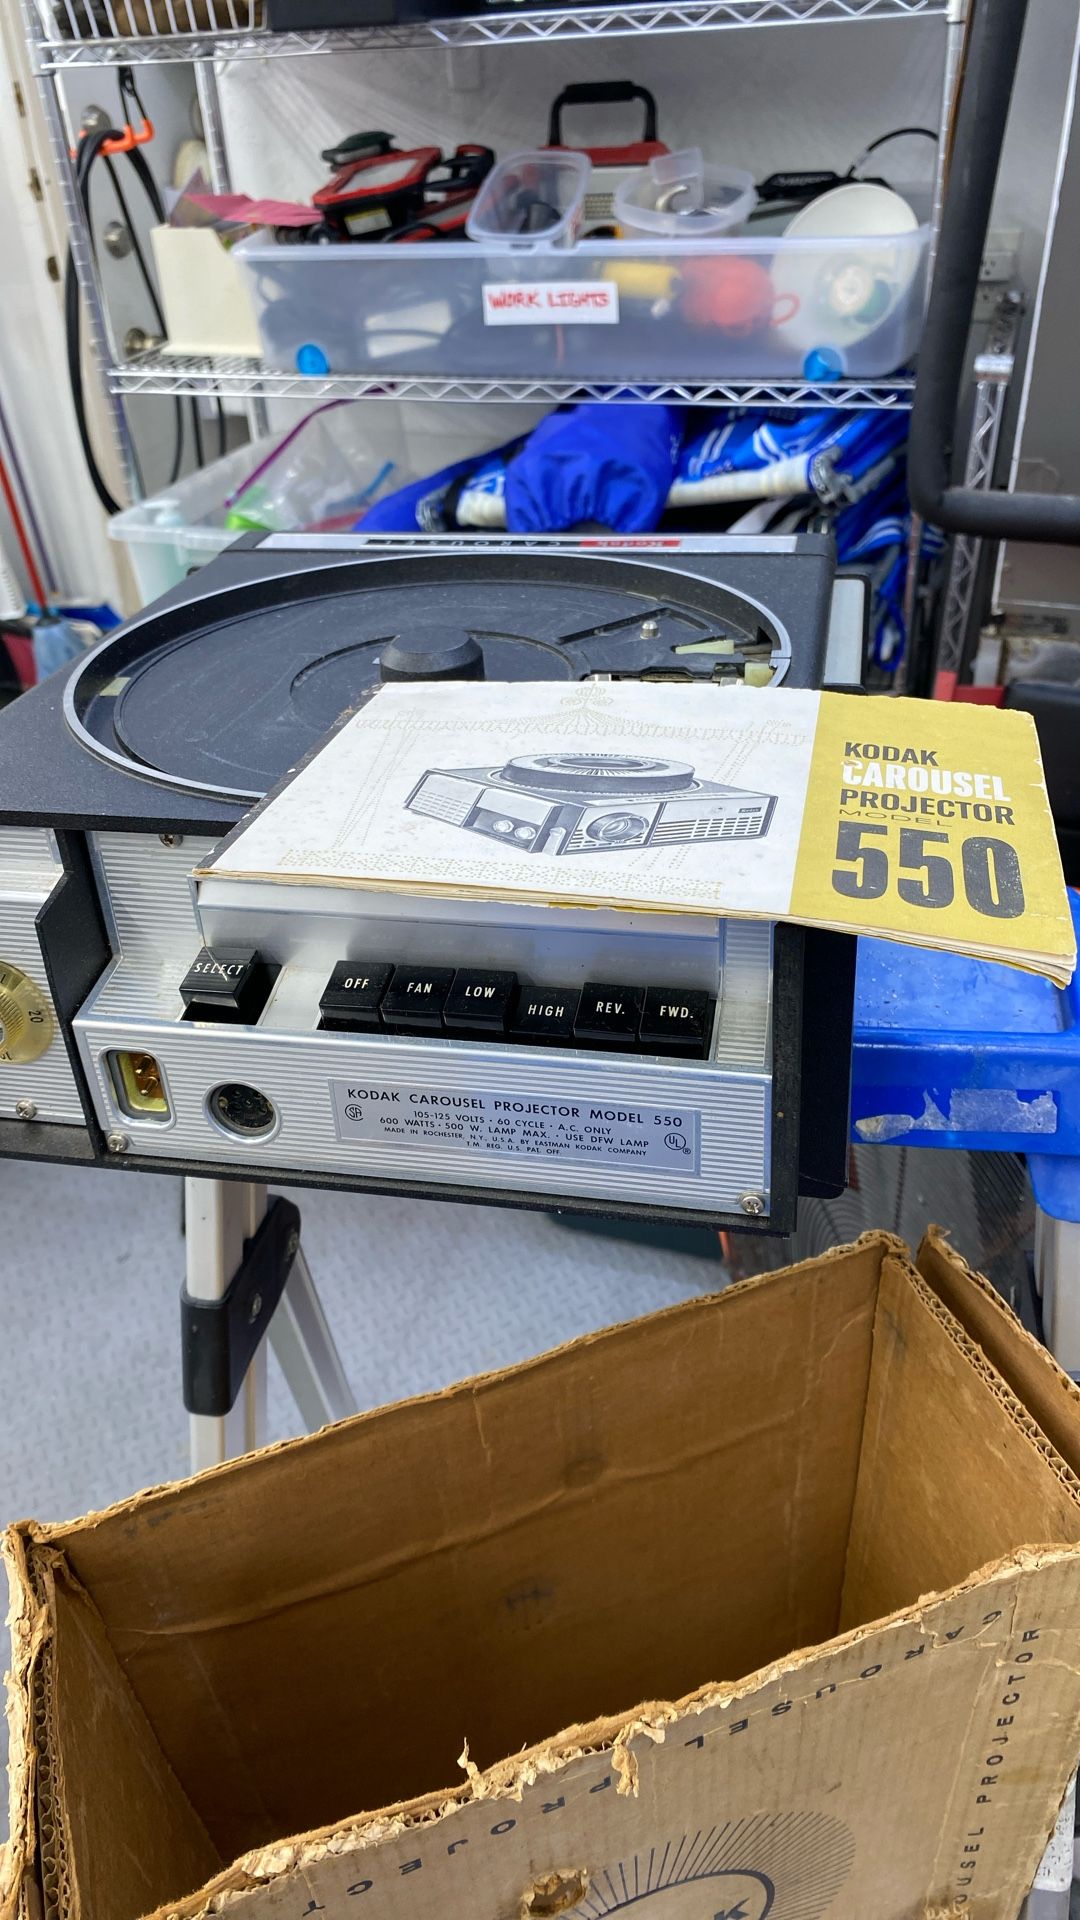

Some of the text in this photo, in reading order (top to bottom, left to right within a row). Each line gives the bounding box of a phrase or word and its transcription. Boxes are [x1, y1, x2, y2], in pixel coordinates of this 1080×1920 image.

[487, 288, 612, 309] WORK LIGHTS
[384, 539, 561, 548] CAROUSEL
[844, 741, 939, 767] KODAK
[841, 760, 1012, 802] CAROUSEL
[839, 788, 1016, 826] PROJECTOR
[839, 809, 953, 828] MODEL
[831, 820, 1025, 919] 550
[193, 962, 245, 977] SELECT
[343, 977, 370, 990] OFF
[406, 982, 433, 995] FAN
[464, 985, 496, 999] LOW
[28, 1010, 44, 1023] 20
[527, 1003, 565, 1018] HIGH
[595, 1001, 625, 1015] REV.
[659, 1005, 694, 1019] FWD.
[347, 1088, 683, 1127] KODAK CAROUSEL PROJECTOR MODEL 550
[379, 1116, 649, 1148] 600 WATTS 500 W. LAMP MAX. USE DFW LAMP
[413, 1110, 612, 1135] 105-125 VOLTS 60 CYCLE A.C. ONLY
[384, 1126, 405, 1134] MADE
[534, 1140, 570, 1149] EASTMAN
[575, 1144, 602, 1152] KODAK
[607, 1147, 647, 1156] COMPANY
[486, 1142, 503, 1150] REG.
[684, 1609, 1003, 1749] CAROUSEL
[975, 1627, 1041, 1804] PROJECTOR
